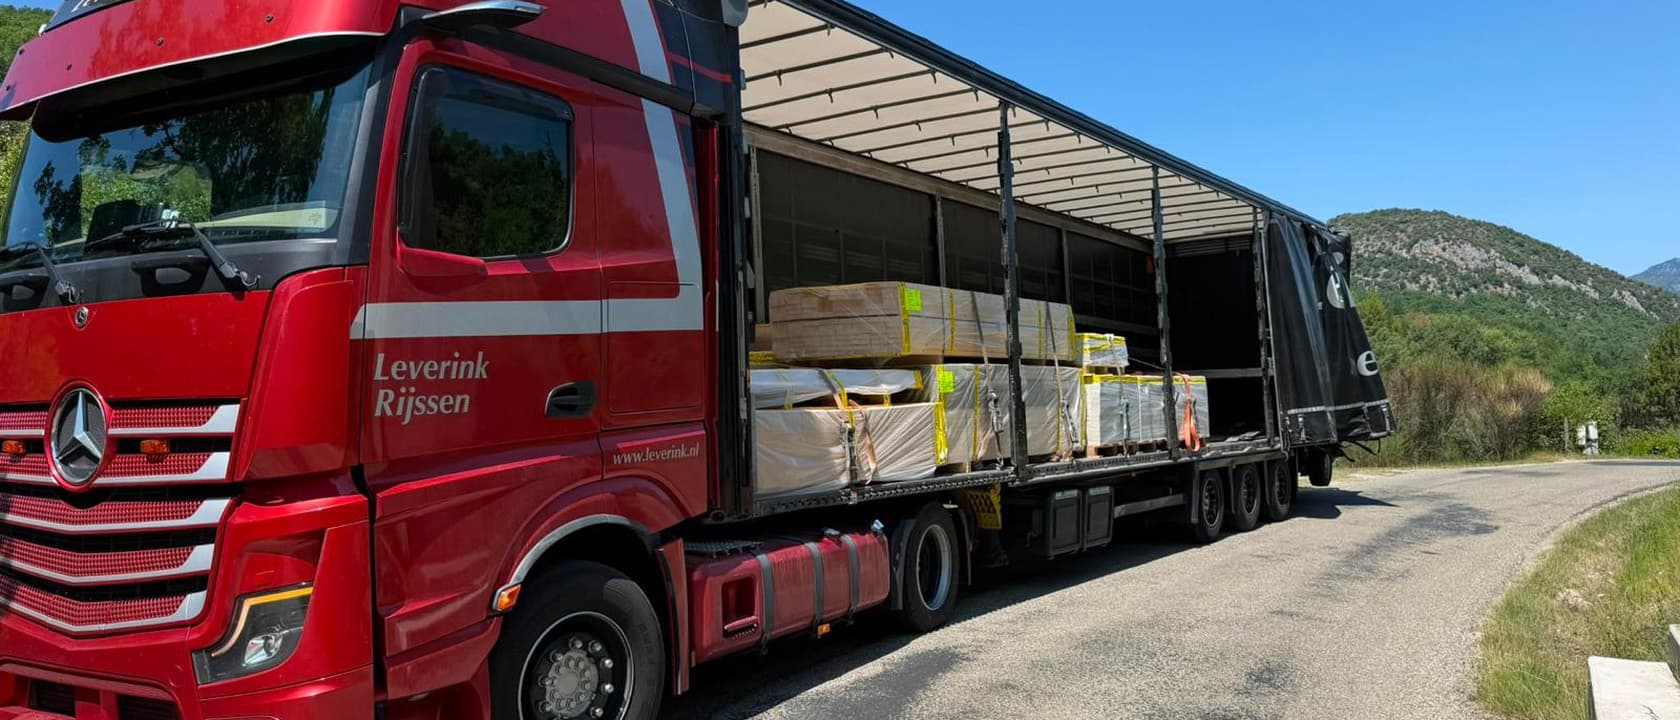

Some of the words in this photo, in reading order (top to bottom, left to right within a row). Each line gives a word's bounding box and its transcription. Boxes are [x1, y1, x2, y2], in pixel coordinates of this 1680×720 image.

[374, 351, 490, 381] Leverink
[374, 386, 471, 426] Rijssen
[612, 441, 700, 465] www.leverink.nl
